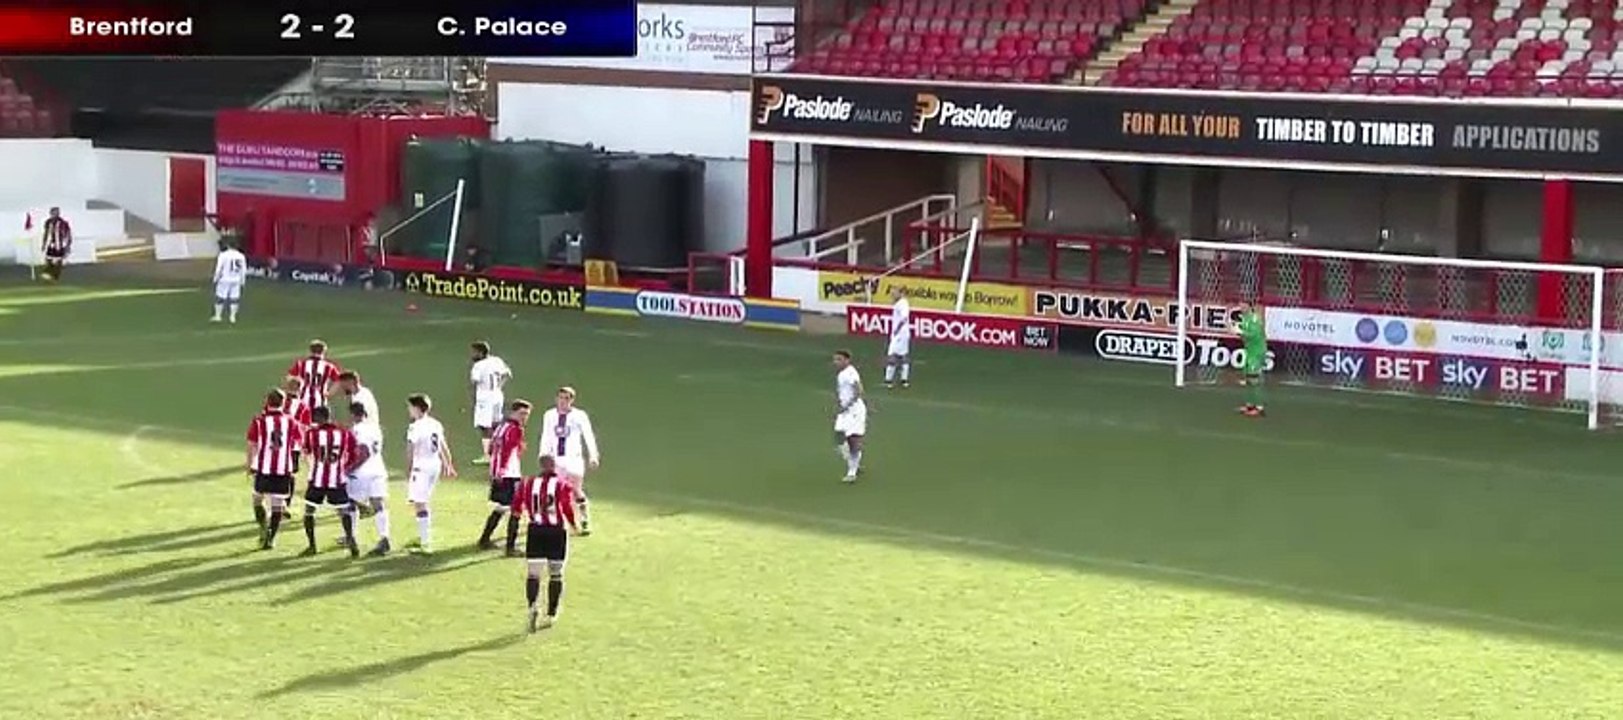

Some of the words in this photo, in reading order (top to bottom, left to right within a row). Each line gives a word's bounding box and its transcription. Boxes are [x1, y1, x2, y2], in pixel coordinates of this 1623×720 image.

[784, 94, 851, 121] Paslode
[939, 101, 1013, 129] Paslode
[1122, 112, 1155, 134] FOR
[1158, 113, 1188, 136] ALL
[1193, 114, 1241, 138] YOUR
[1255, 117, 1326, 142] TIMBER
[1331, 120, 1355, 143] TO
[1360, 122, 1434, 147] TIMBER
[1452, 124, 1600, 153] APPLICATIONS
[422, 272, 582, 308] TradePoint.co.uk
[640, 295, 742, 319] TOOLSTATION
[850, 311, 1016, 345] MATHBOOK.COM
[1283, 319, 1336, 333] NOVOTEL
[1105, 336, 1179, 359] DRAPE
[1196, 339, 1275, 370] Toos
[1321, 350, 1363, 379] sky
[1375, 357, 1430, 382] BET
[1443, 360, 1487, 389] sky
[1500, 367, 1558, 393] BET
